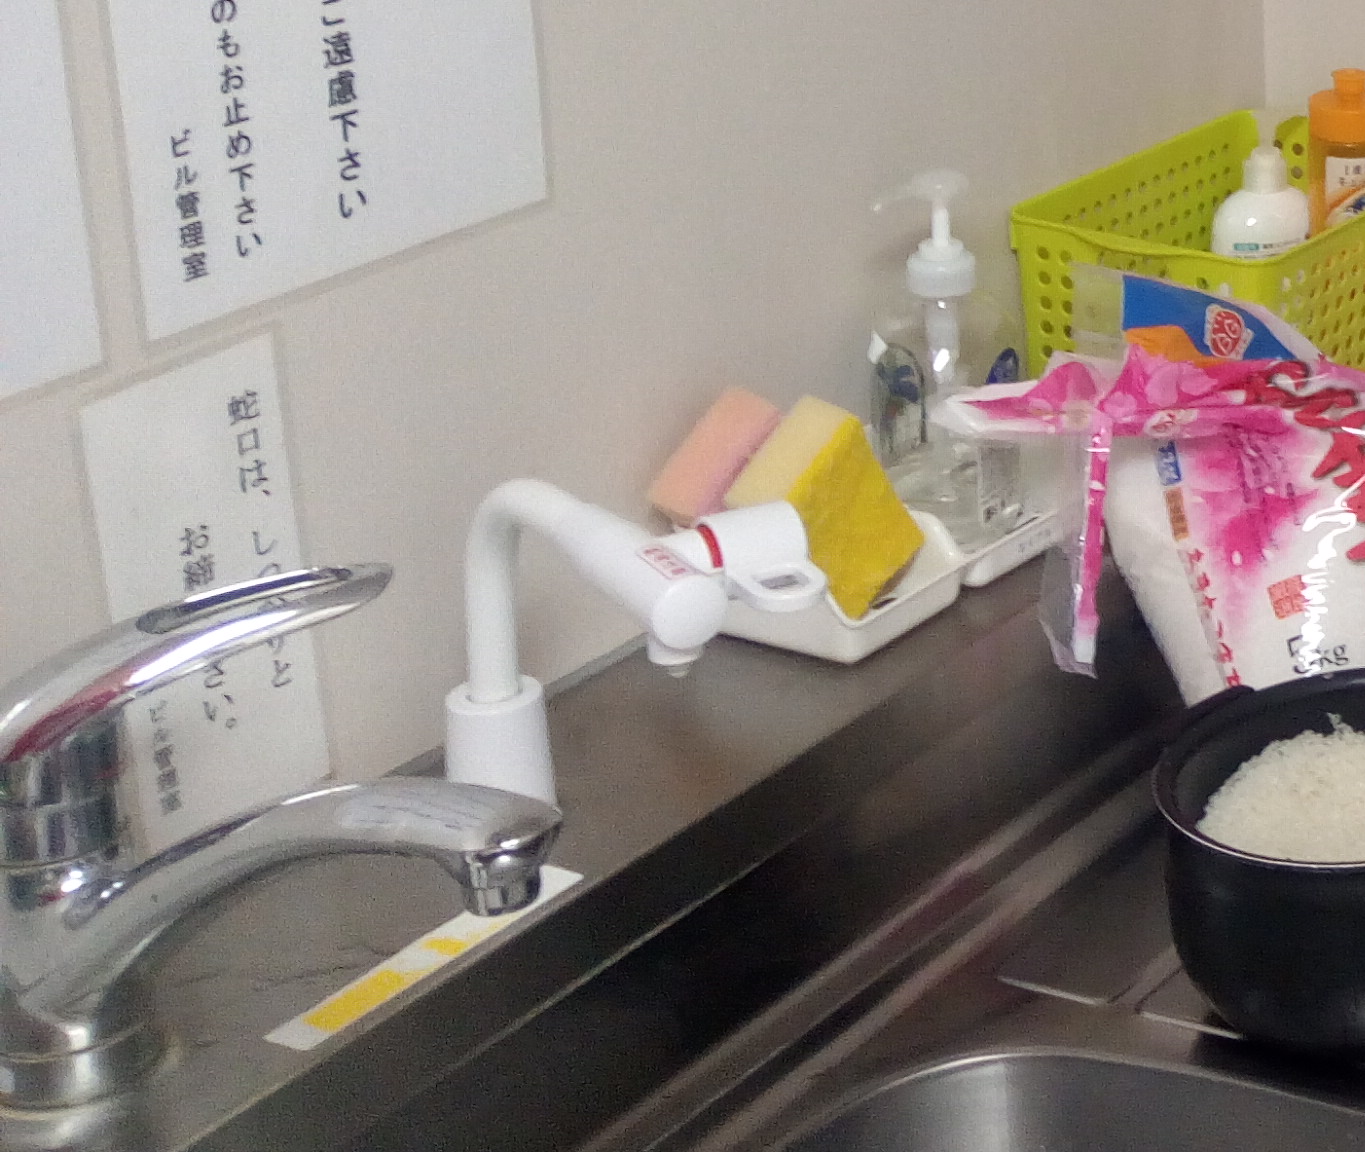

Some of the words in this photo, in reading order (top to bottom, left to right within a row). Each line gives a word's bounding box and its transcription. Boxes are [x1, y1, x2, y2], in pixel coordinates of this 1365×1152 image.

[168, 128, 208, 283] ビル管理室
